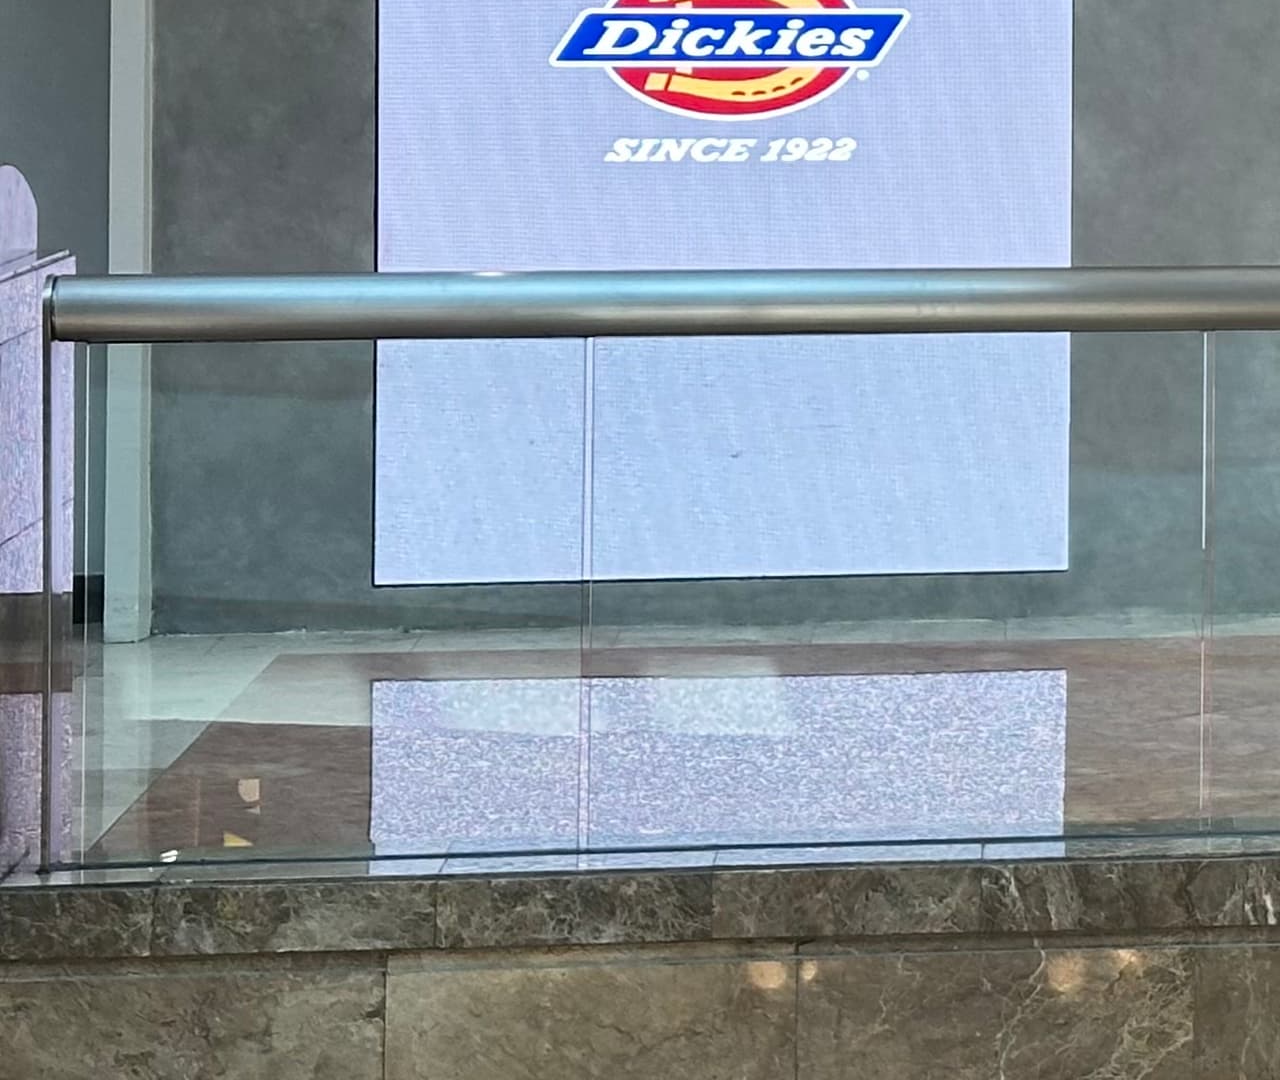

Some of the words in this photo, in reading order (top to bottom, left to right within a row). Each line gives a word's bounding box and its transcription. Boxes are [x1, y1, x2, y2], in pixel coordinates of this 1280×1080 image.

[583, 19, 874, 57] Dickies
[604, 137, 759, 162] SINCE
[760, 137, 858, 162] 1922
